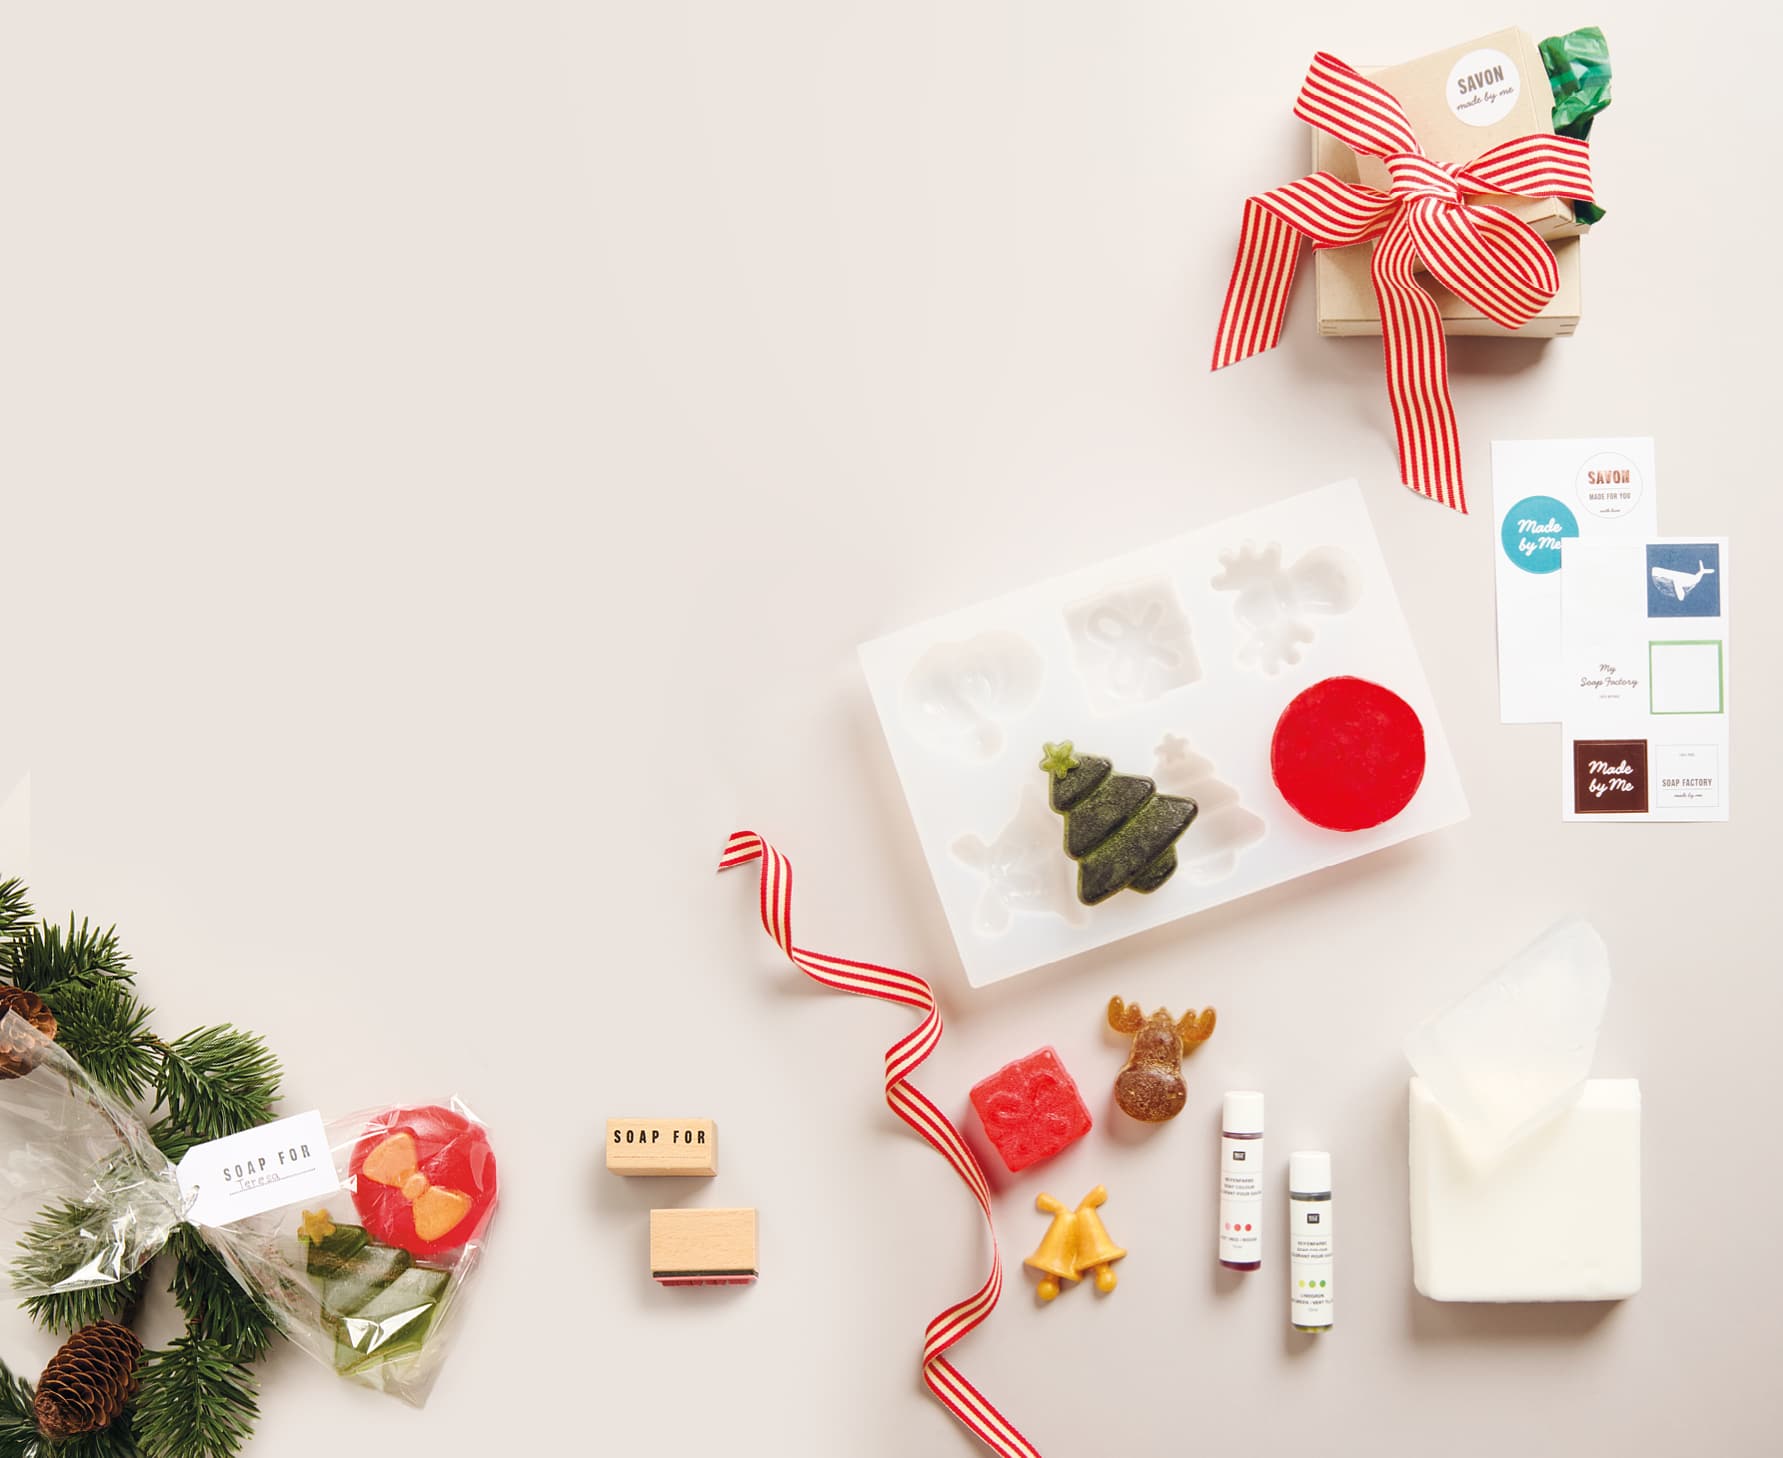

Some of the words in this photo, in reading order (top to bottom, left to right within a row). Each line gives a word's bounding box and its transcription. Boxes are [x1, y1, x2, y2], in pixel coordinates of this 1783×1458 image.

[1457, 65, 1504, 95] SAVON
[1457, 95, 1482, 111] made
[1484, 92, 1497, 104] by
[1499, 87, 1514, 97] me
[1587, 469, 1630, 485] SAVON
[1589, 492, 1605, 501] MADE
[1606, 492, 1618, 500] FOR
[1619, 492, 1631, 500] YOU
[1517, 517, 1562, 534] Made
[1518, 537, 1538, 557] by
[1538, 536, 1562, 550] Me
[1599, 663, 1616, 675] My
[1580, 677, 1603, 689] Soap
[1604, 676, 1638, 689] Factory
[1588, 759, 1634, 775] Made
[1588, 778, 1608, 798] by
[1608, 777, 1634, 792] Me
[1661, 778, 1680, 788] SOAP
[1681, 777, 1713, 787] FACTORY
[613, 1129, 660, 1144] SOAP
[673, 1130, 706, 1144] FOR
[223, 1157, 266, 1181] SOAP
[277, 1144, 311, 1165] FOR
[236, 1172, 281, 1191] Teresa
